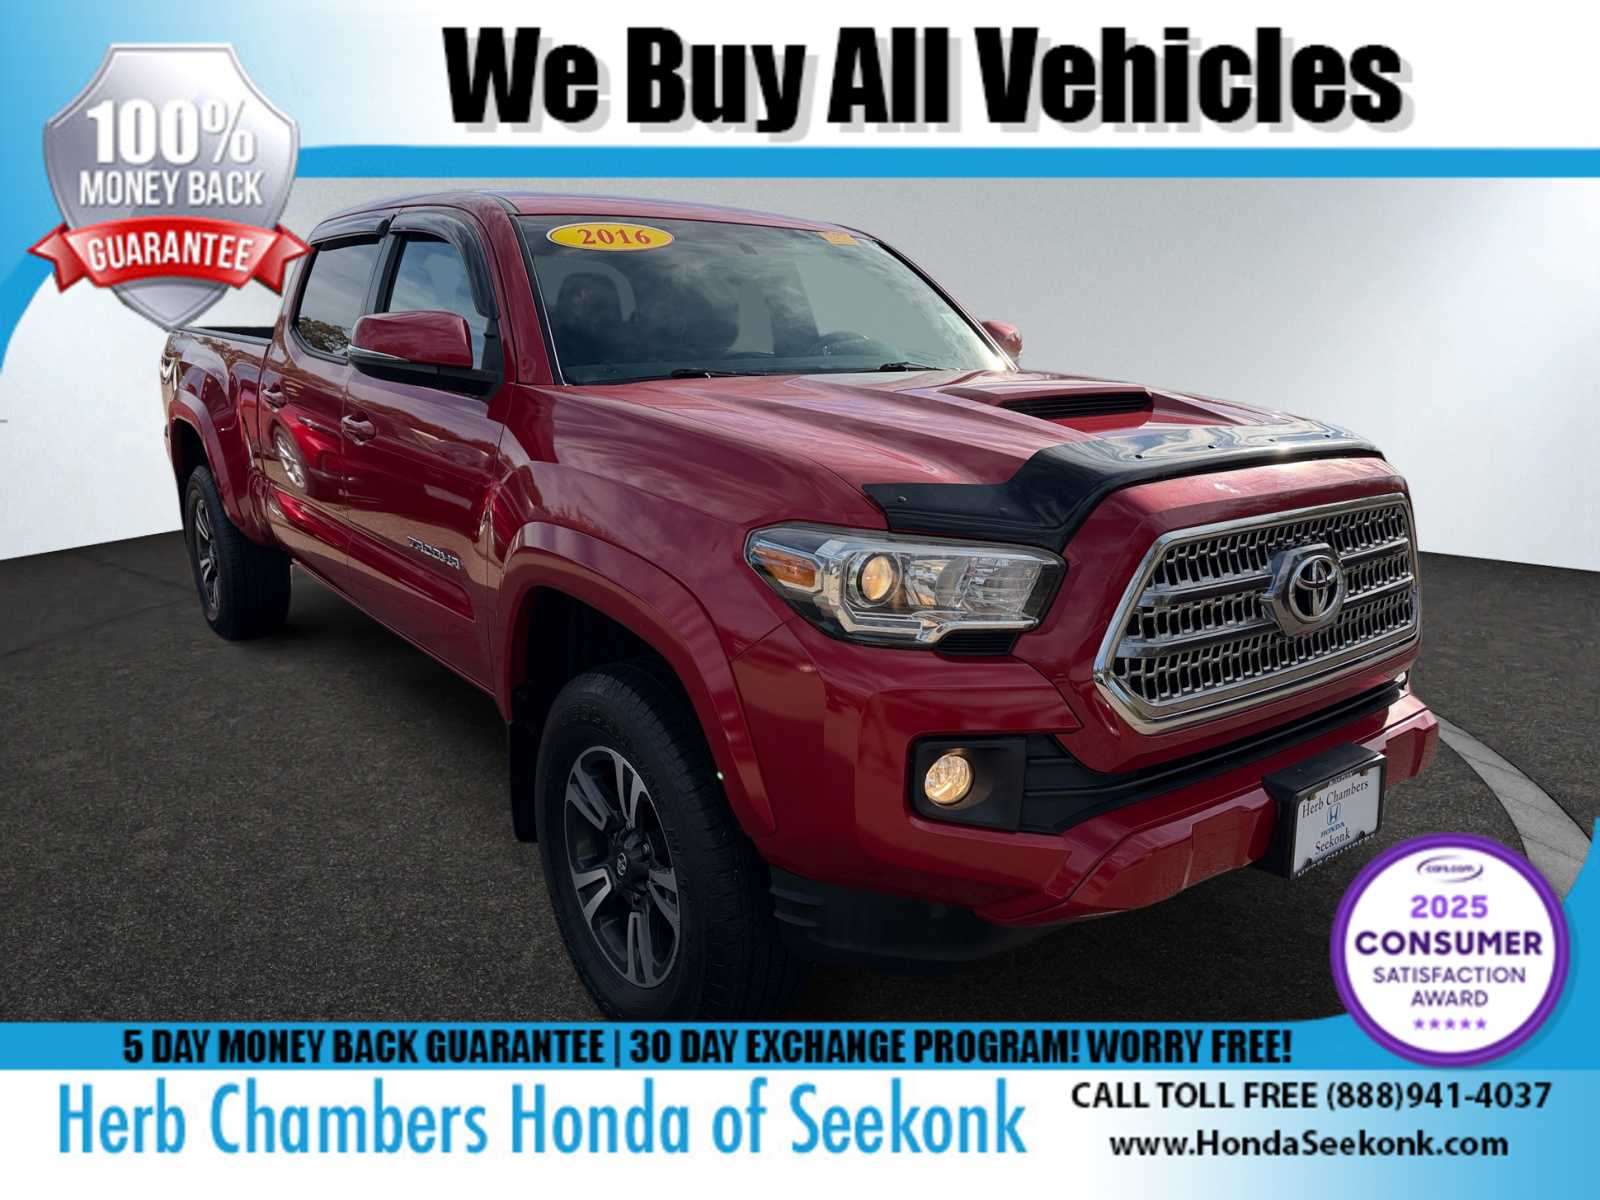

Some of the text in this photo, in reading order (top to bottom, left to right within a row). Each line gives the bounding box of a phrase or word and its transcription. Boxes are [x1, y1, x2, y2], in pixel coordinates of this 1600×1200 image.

[577, 229, 651, 245] 2016
[1301, 780, 1370, 819] Herb Chambers
[1314, 827, 1351, 855] Seekonk
